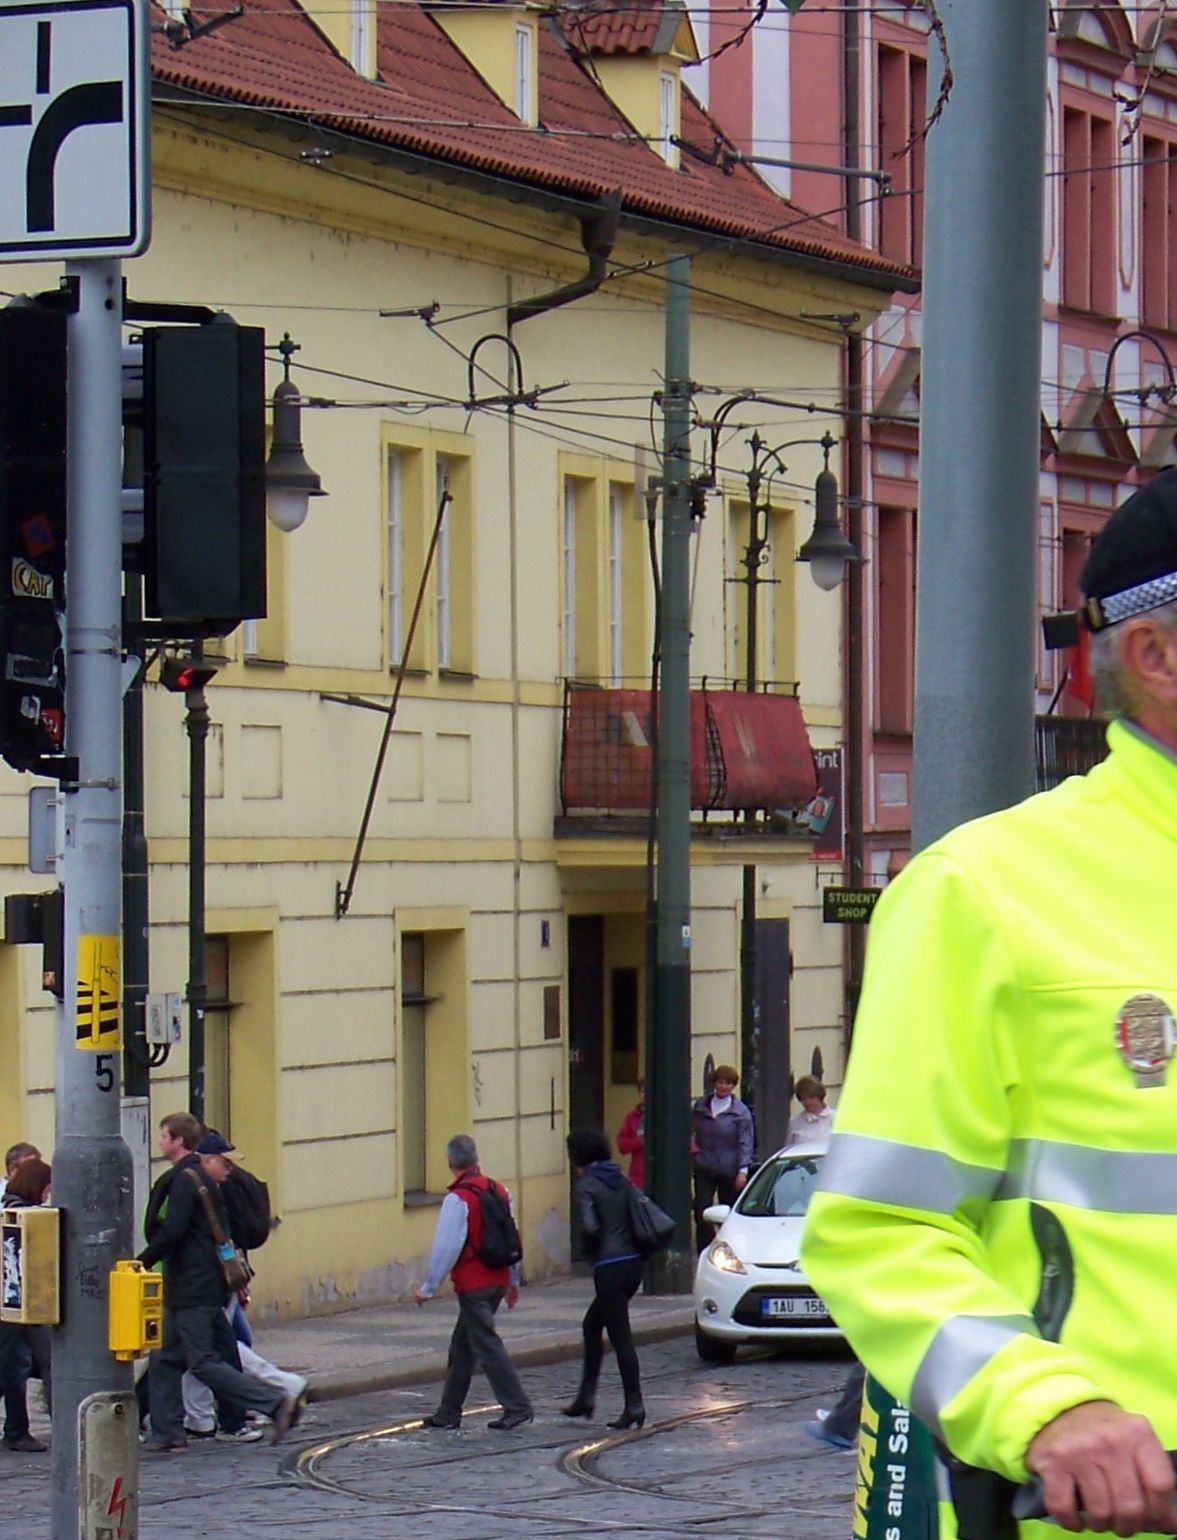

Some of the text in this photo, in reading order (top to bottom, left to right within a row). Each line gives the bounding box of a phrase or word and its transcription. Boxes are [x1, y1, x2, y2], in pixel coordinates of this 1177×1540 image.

[828, 892, 876, 903] STUDENT
[837, 907, 867, 919] SHOP
[95, 1054, 114, 1092] 5
[772, 1300, 831, 1314] 1AU 158
[886, 1464, 907, 1517] and
